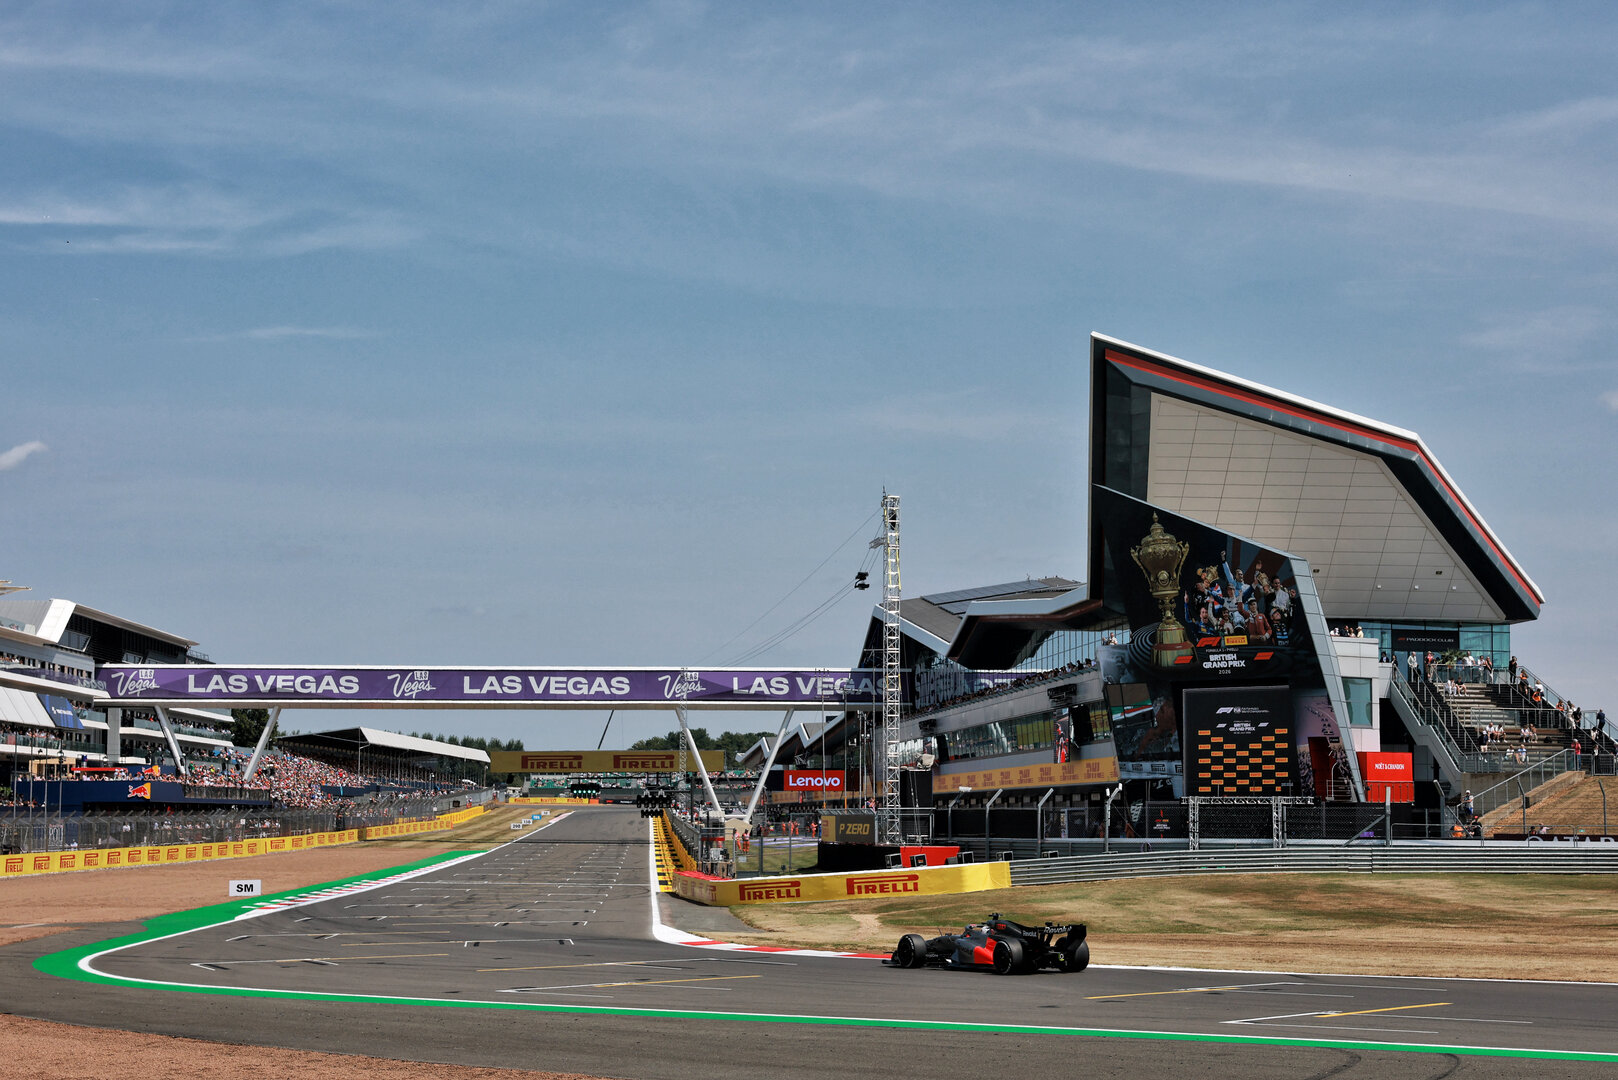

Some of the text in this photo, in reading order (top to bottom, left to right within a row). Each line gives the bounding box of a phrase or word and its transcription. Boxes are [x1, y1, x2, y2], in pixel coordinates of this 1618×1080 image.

[1203, 661, 1228, 669] GRAND
[1209, 653, 1237, 661] BRITISH
[139, 670, 154, 679] LAS
[111, 671, 160, 697] Vegas
[188, 674, 360, 694] LAS VEGAS
[387, 672, 436, 698] Vegas
[463, 675, 631, 695] LAS VEGAS
[658, 674, 707, 699] Vegas
[732, 676, 790, 695] LAS
[521, 755, 583, 769] PIRELLI
[613, 755, 675, 769] PIRELLI
[789, 775, 841, 786] Lenovo
[839, 824, 845, 834] P
[846, 824, 870, 835] ZERO
[236, 884, 254, 892] SM
[739, 881, 801, 901] PIRELLI
[846, 874, 919, 895] PIRELLI
